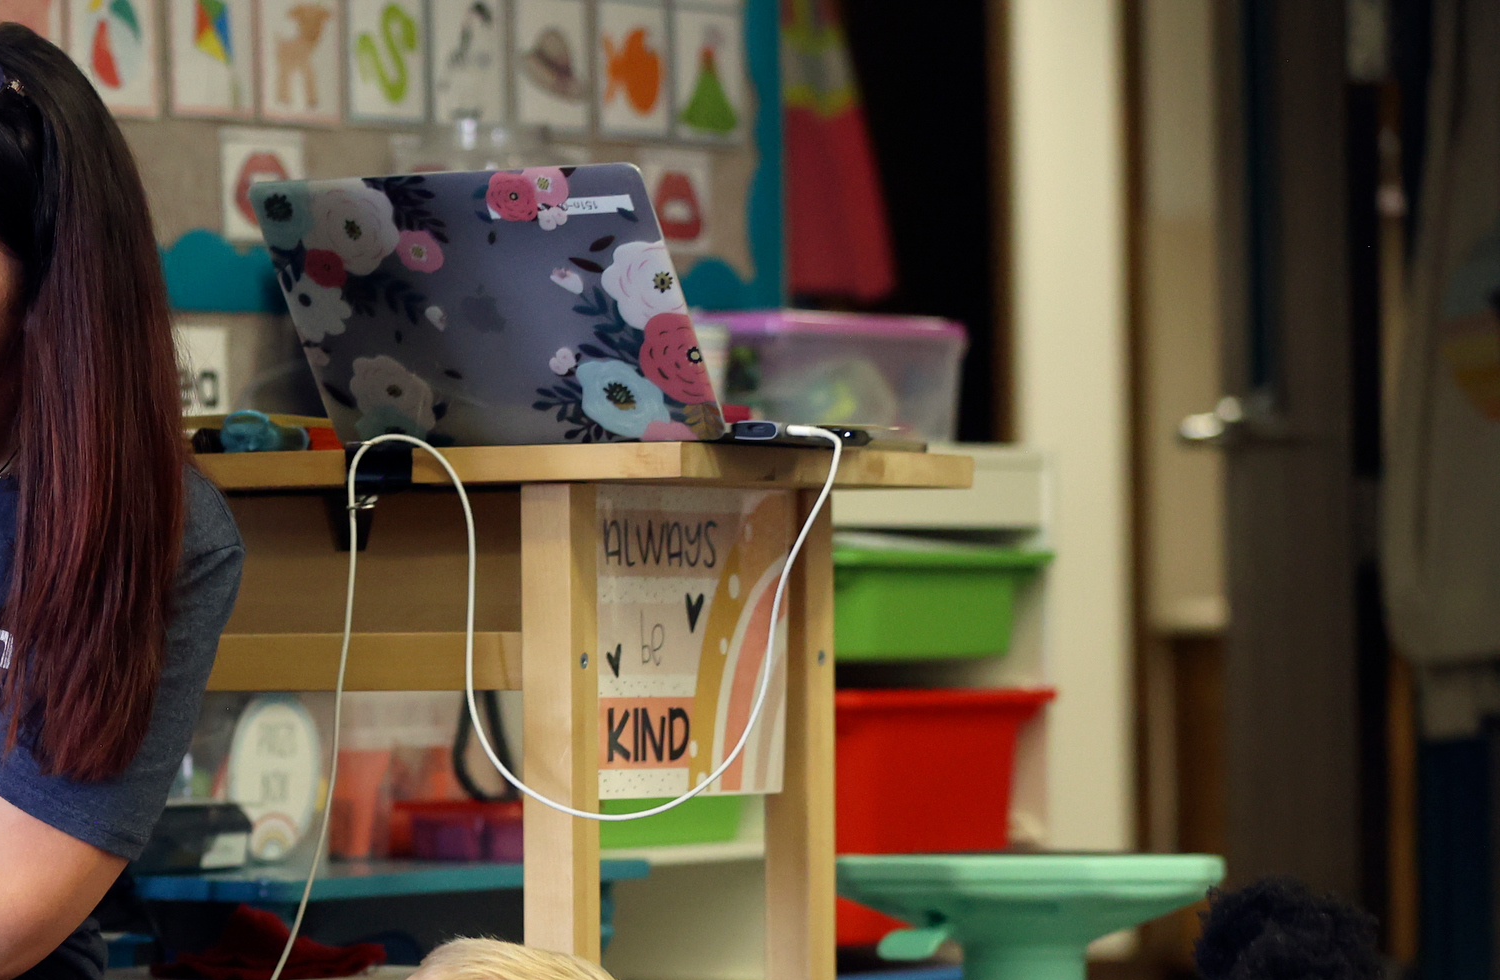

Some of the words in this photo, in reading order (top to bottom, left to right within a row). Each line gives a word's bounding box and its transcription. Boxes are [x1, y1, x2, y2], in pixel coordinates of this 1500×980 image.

[603, 519, 718, 568] ALWAYS
[640, 609, 665, 666] be
[607, 707, 689, 763] KIND
